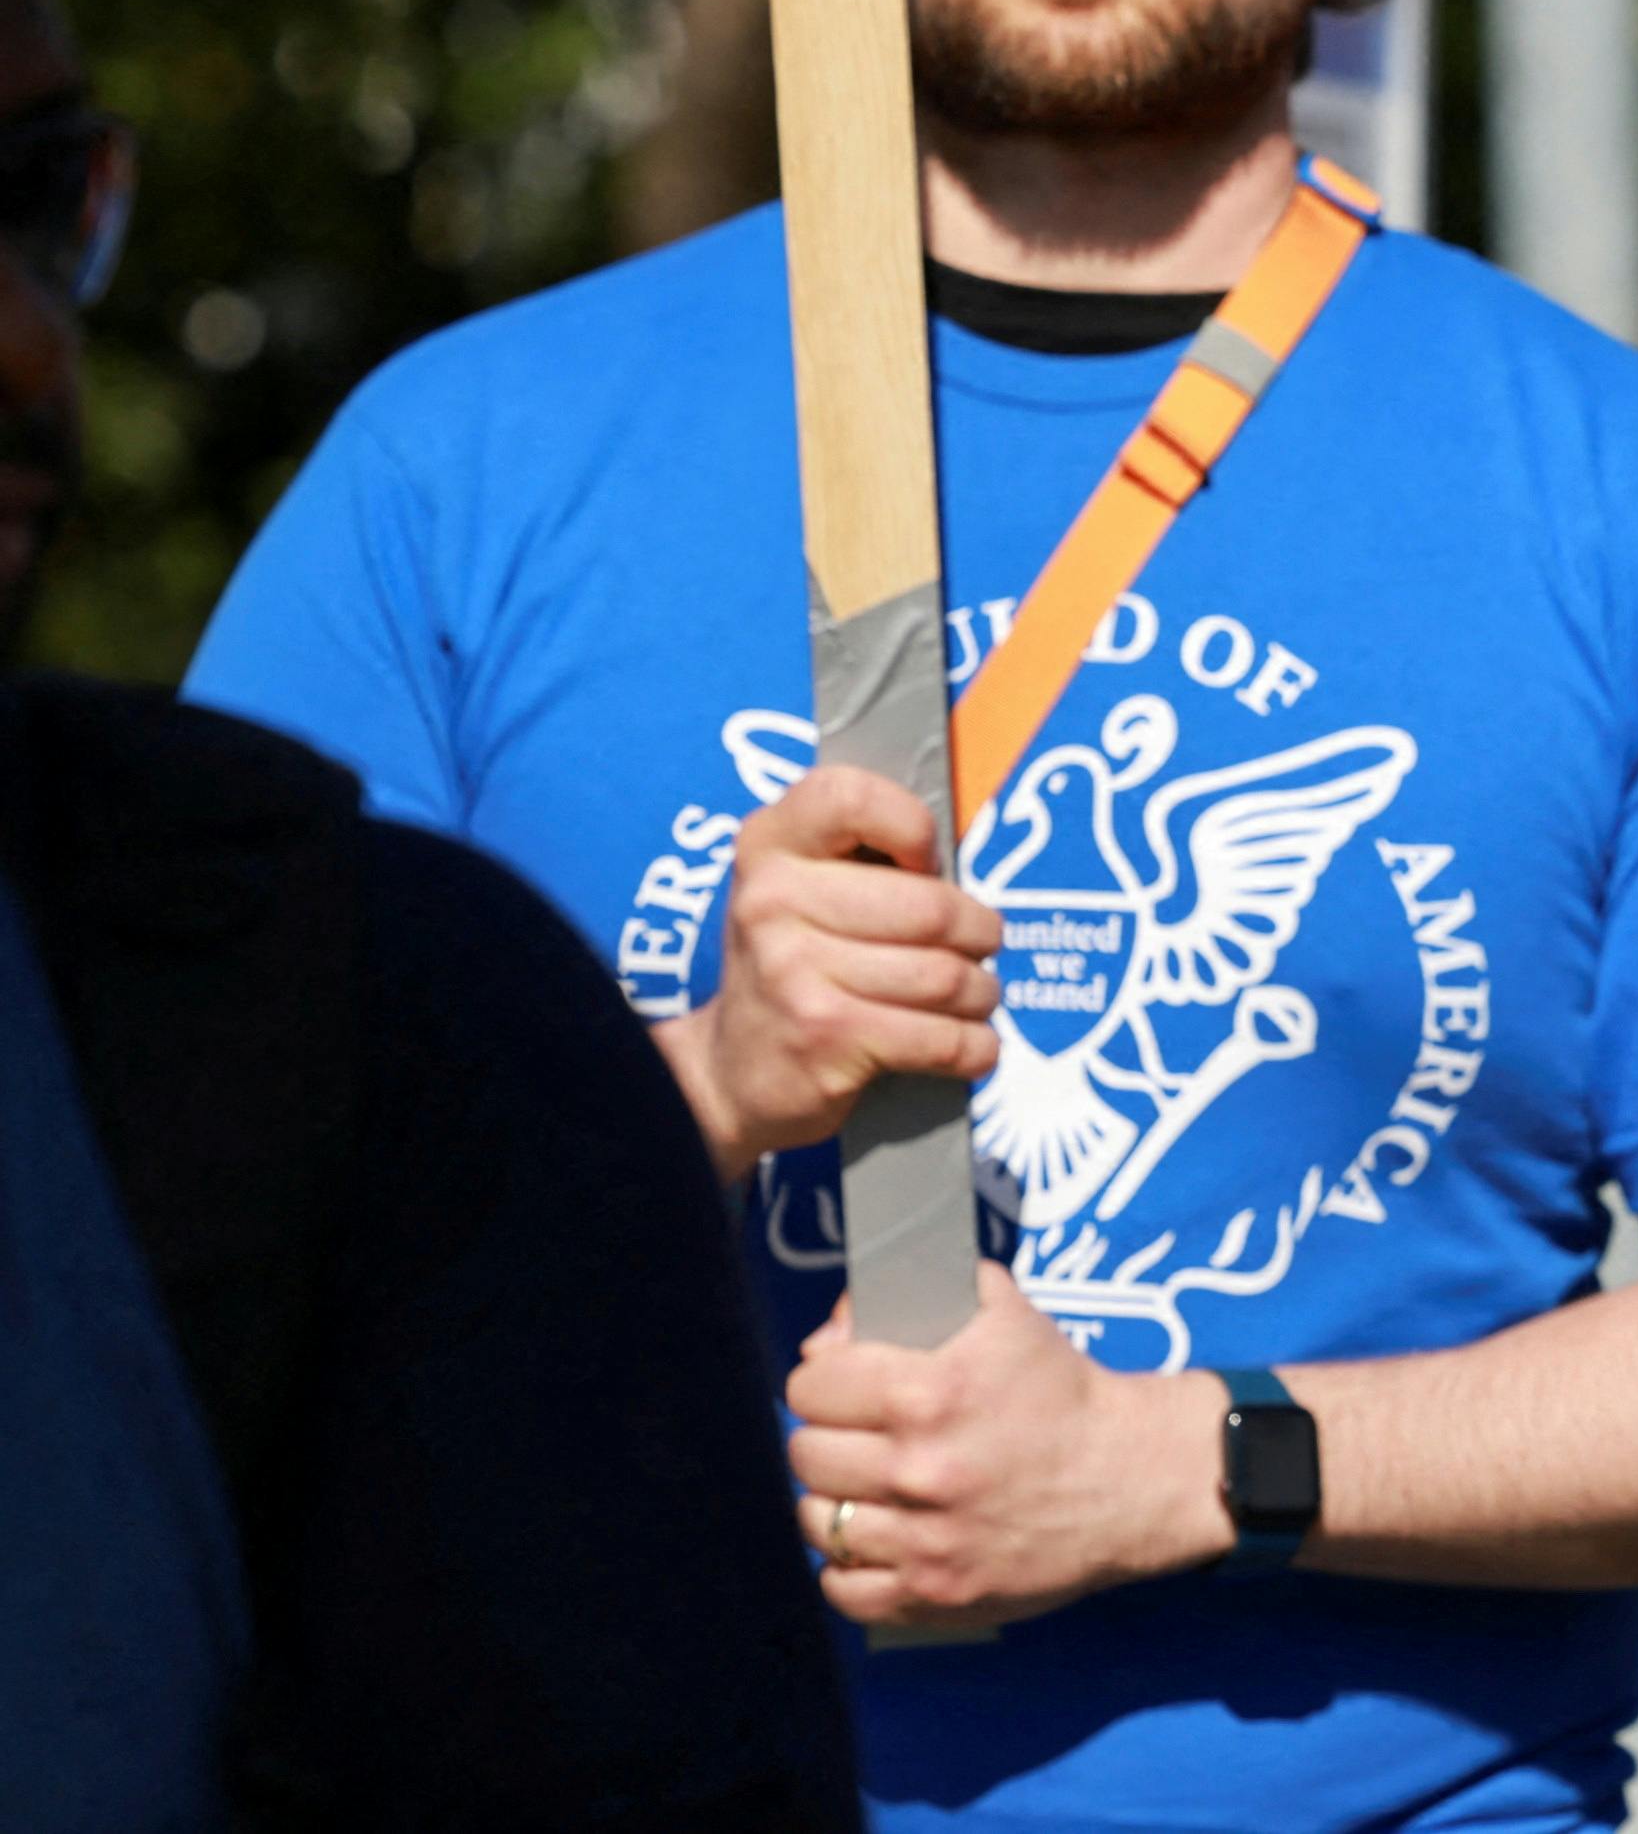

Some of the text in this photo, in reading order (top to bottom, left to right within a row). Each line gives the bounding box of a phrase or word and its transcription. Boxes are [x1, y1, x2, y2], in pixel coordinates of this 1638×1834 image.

[1002, 910, 1122, 954] united
[1180, 613, 1319, 718] OF
[1319, 837, 1490, 1225] AMERICA
[1031, 951, 1086, 981] we
[1004, 972, 1108, 1013] stand
